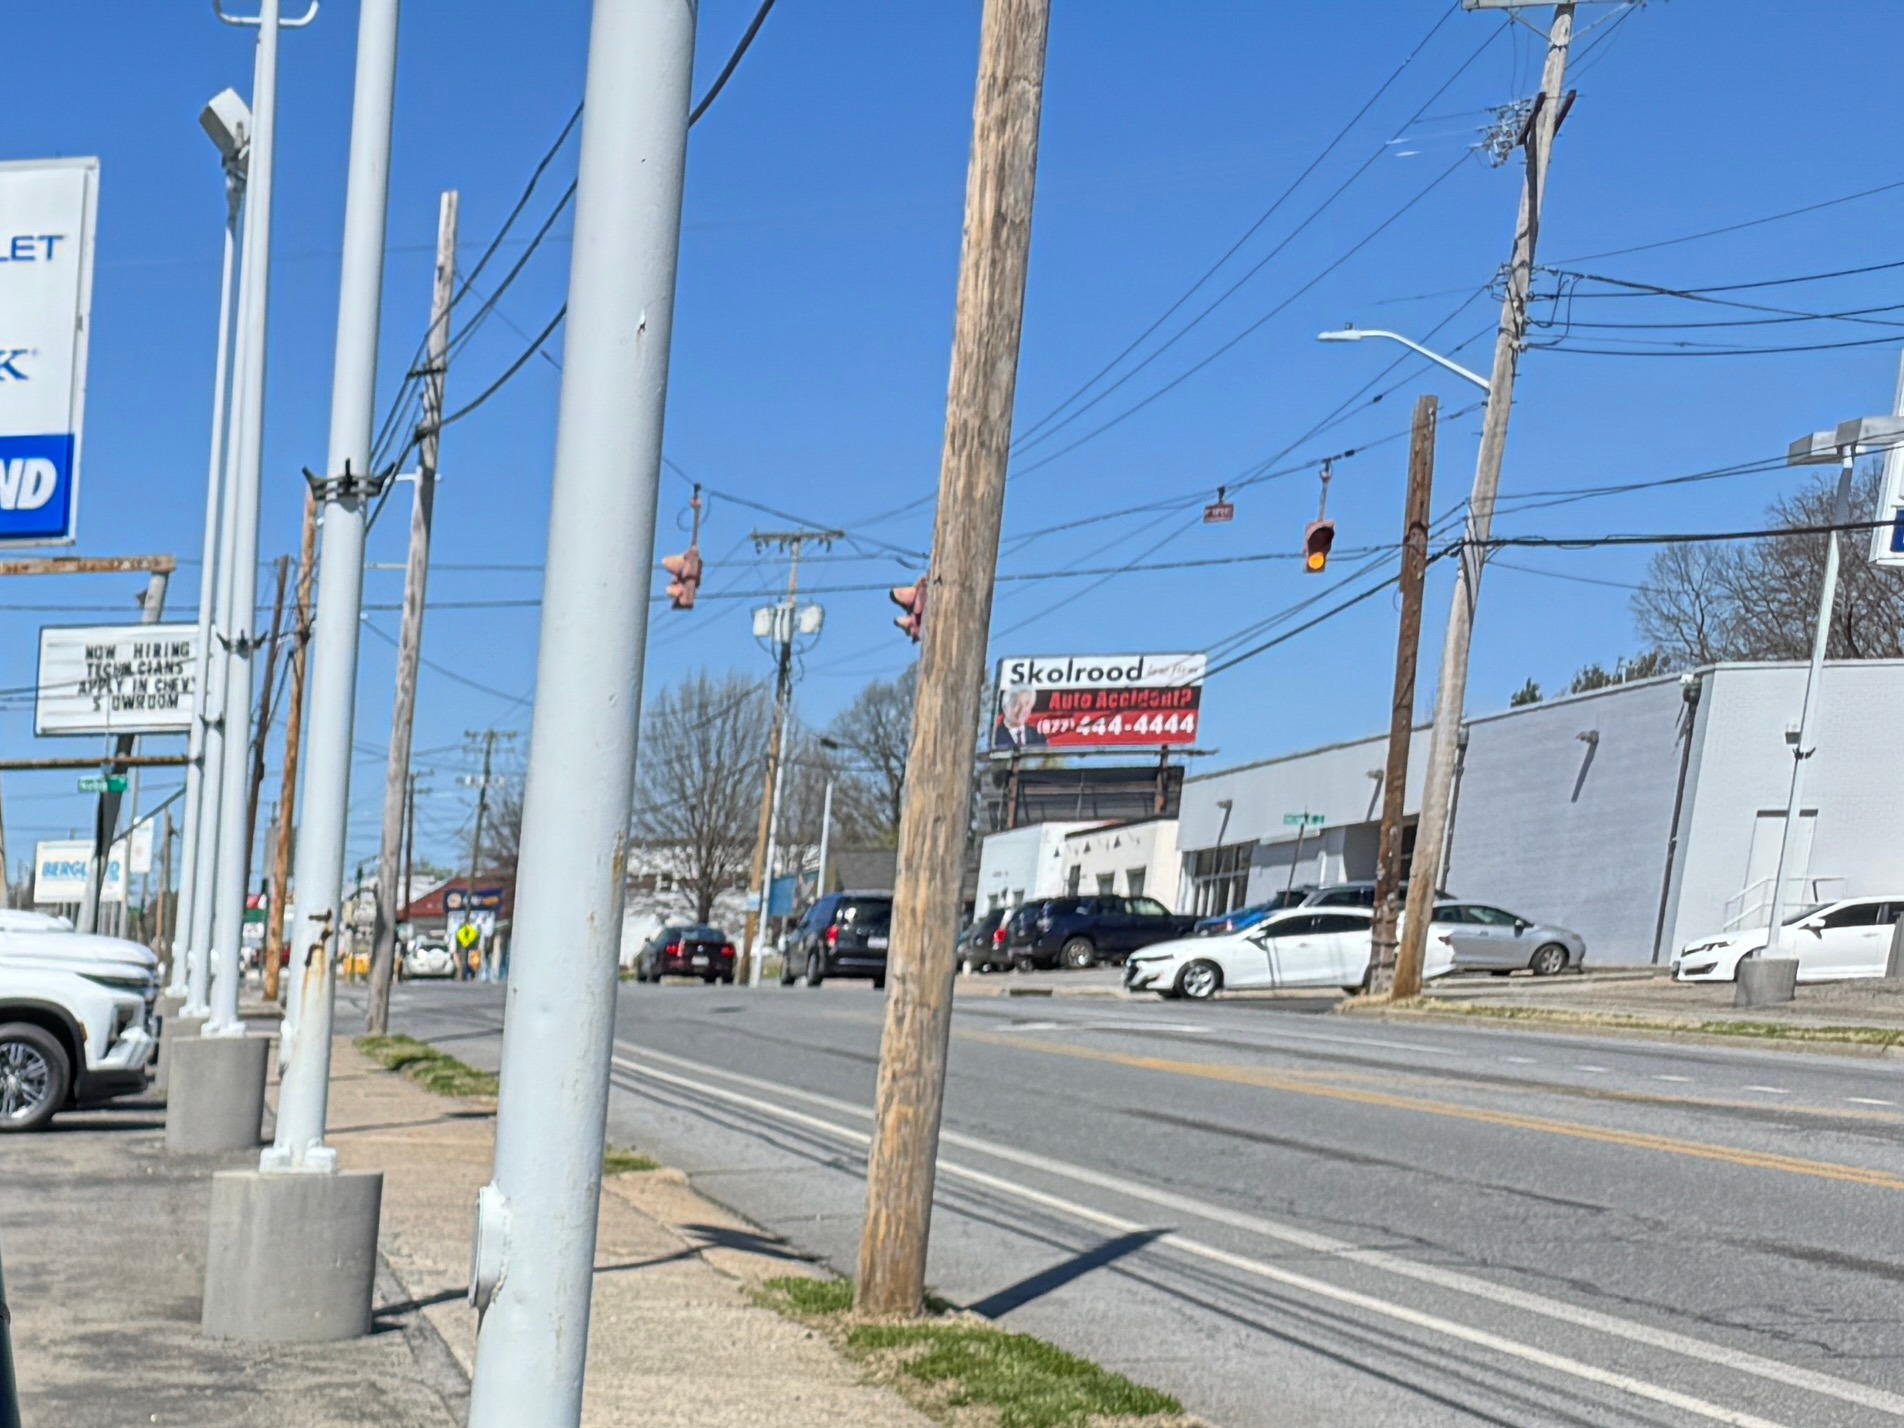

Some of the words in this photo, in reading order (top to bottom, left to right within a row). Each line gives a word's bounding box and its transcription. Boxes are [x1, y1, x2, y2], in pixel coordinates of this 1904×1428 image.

[85, 644, 117, 660] NOW
[133, 641, 190, 659] HIRING
[1009, 656, 1144, 685] Skolrood
[78, 679, 124, 697] APPLY
[133, 677, 148, 693] IN
[1049, 690, 1093, 710] Auto
[1076, 712, 1195, 736] 444-4444
